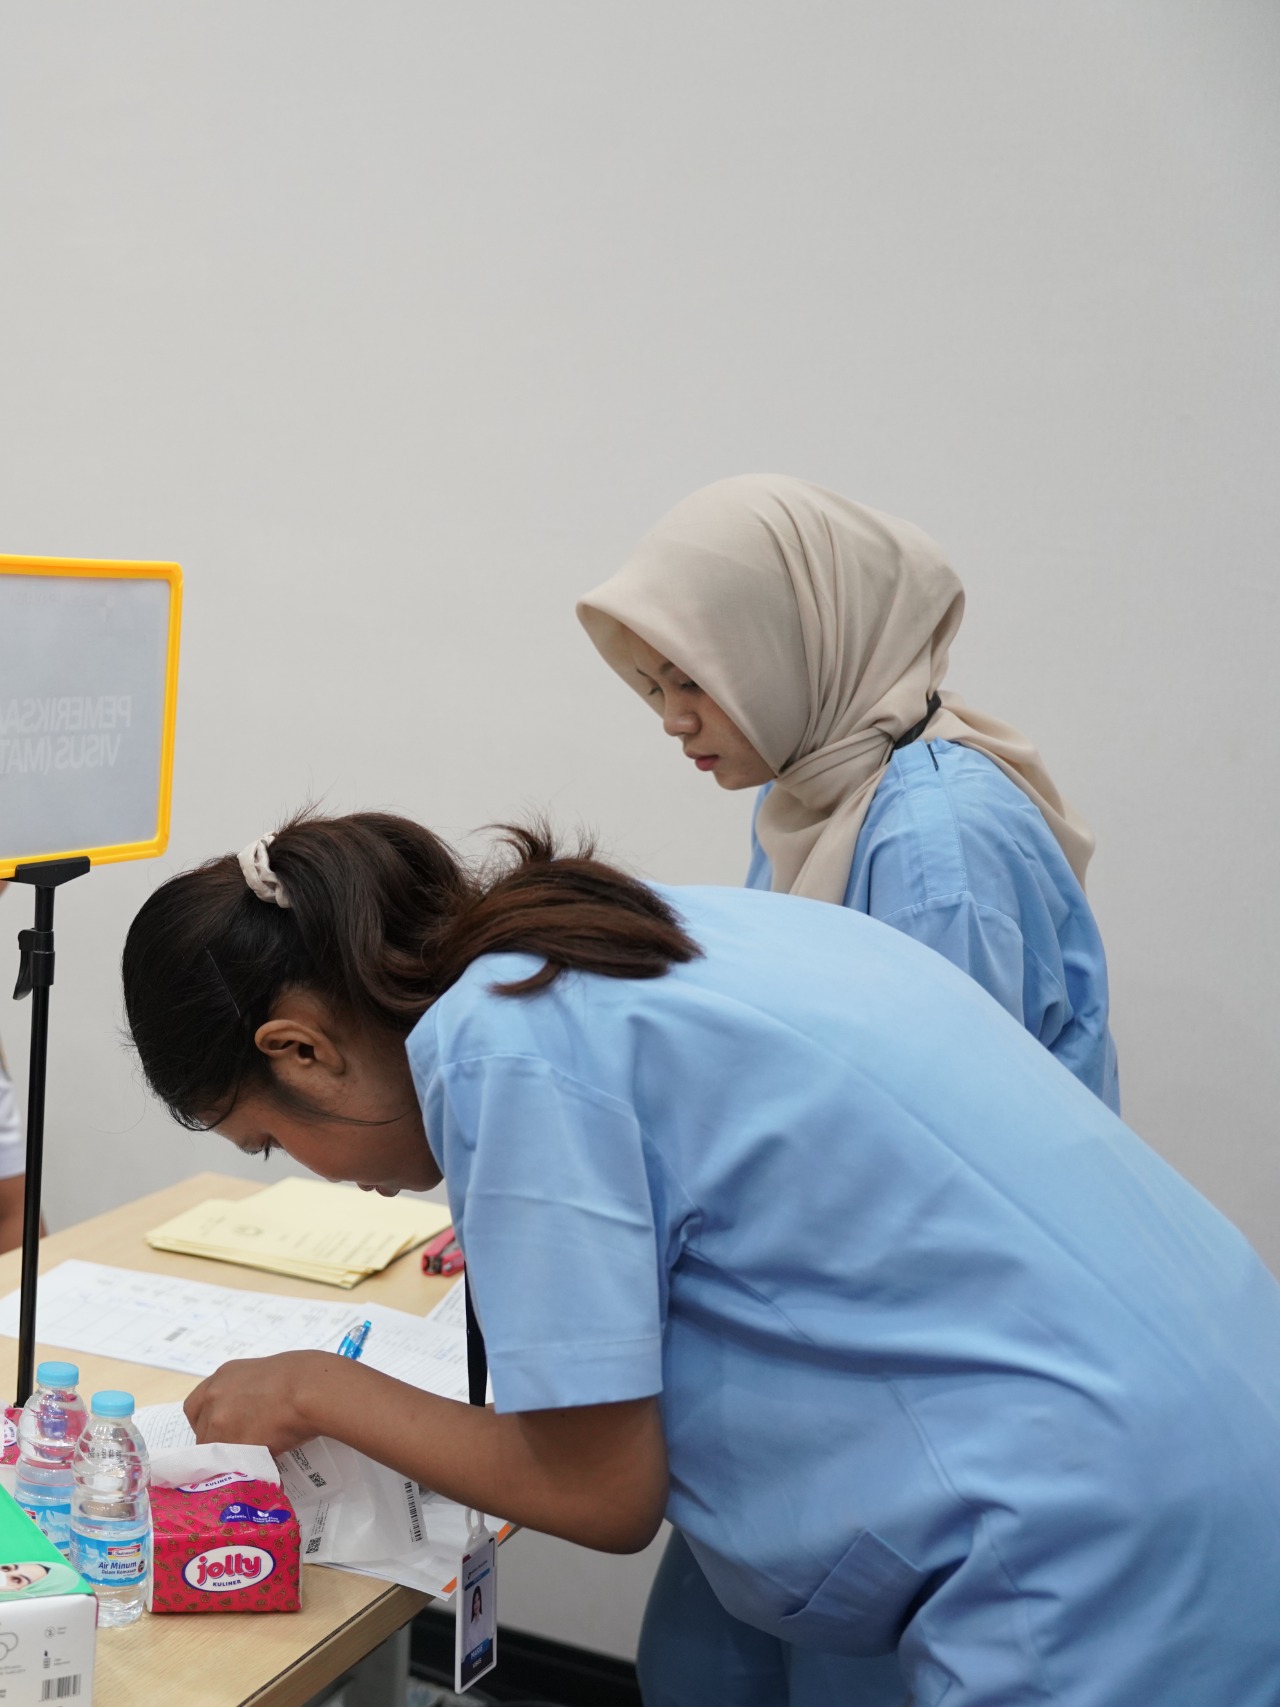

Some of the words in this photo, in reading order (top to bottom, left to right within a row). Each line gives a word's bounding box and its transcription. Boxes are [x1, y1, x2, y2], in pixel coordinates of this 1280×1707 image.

[204, 1476, 233, 1487] KULINER
[98, 1561, 109, 1570] Air
[110, 1560, 137, 1570] Minum
[196, 1552, 262, 1586] jolly
[212, 1579, 242, 1587] KULINER
